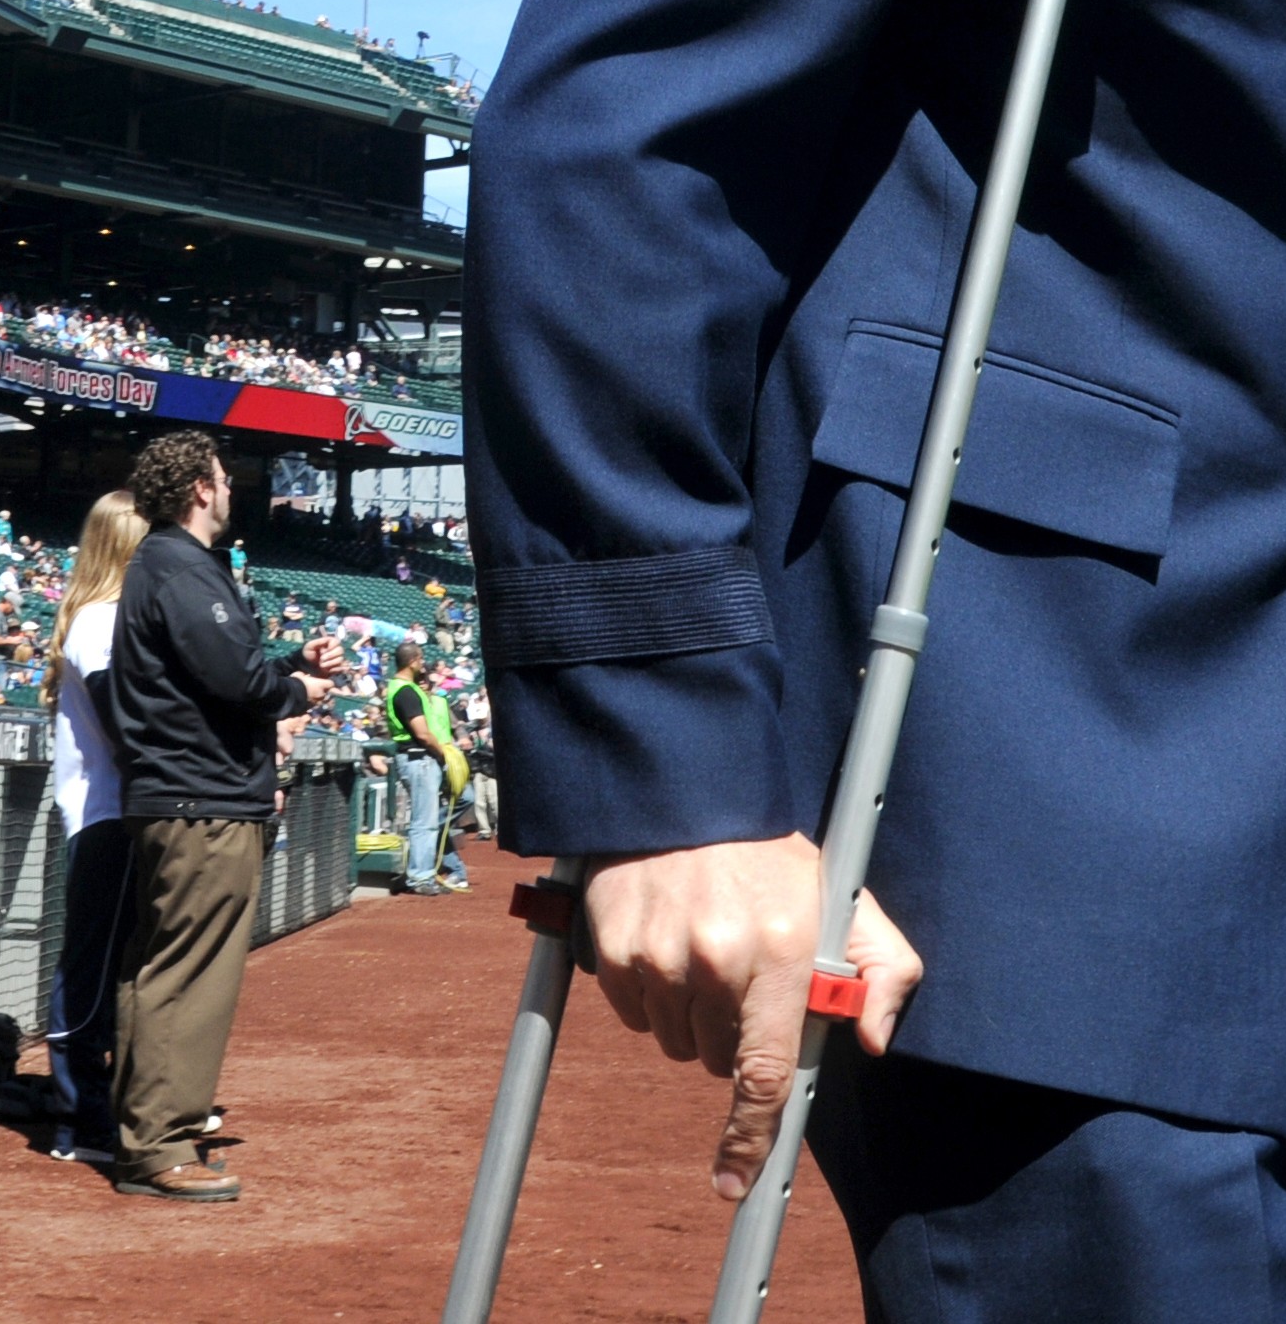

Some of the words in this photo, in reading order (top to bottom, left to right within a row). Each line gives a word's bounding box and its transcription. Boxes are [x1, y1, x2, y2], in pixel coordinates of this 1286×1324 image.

[46, 360, 115, 402] Forces
[115, 371, 159, 412] Day
[372, 410, 459, 440] BOEING
